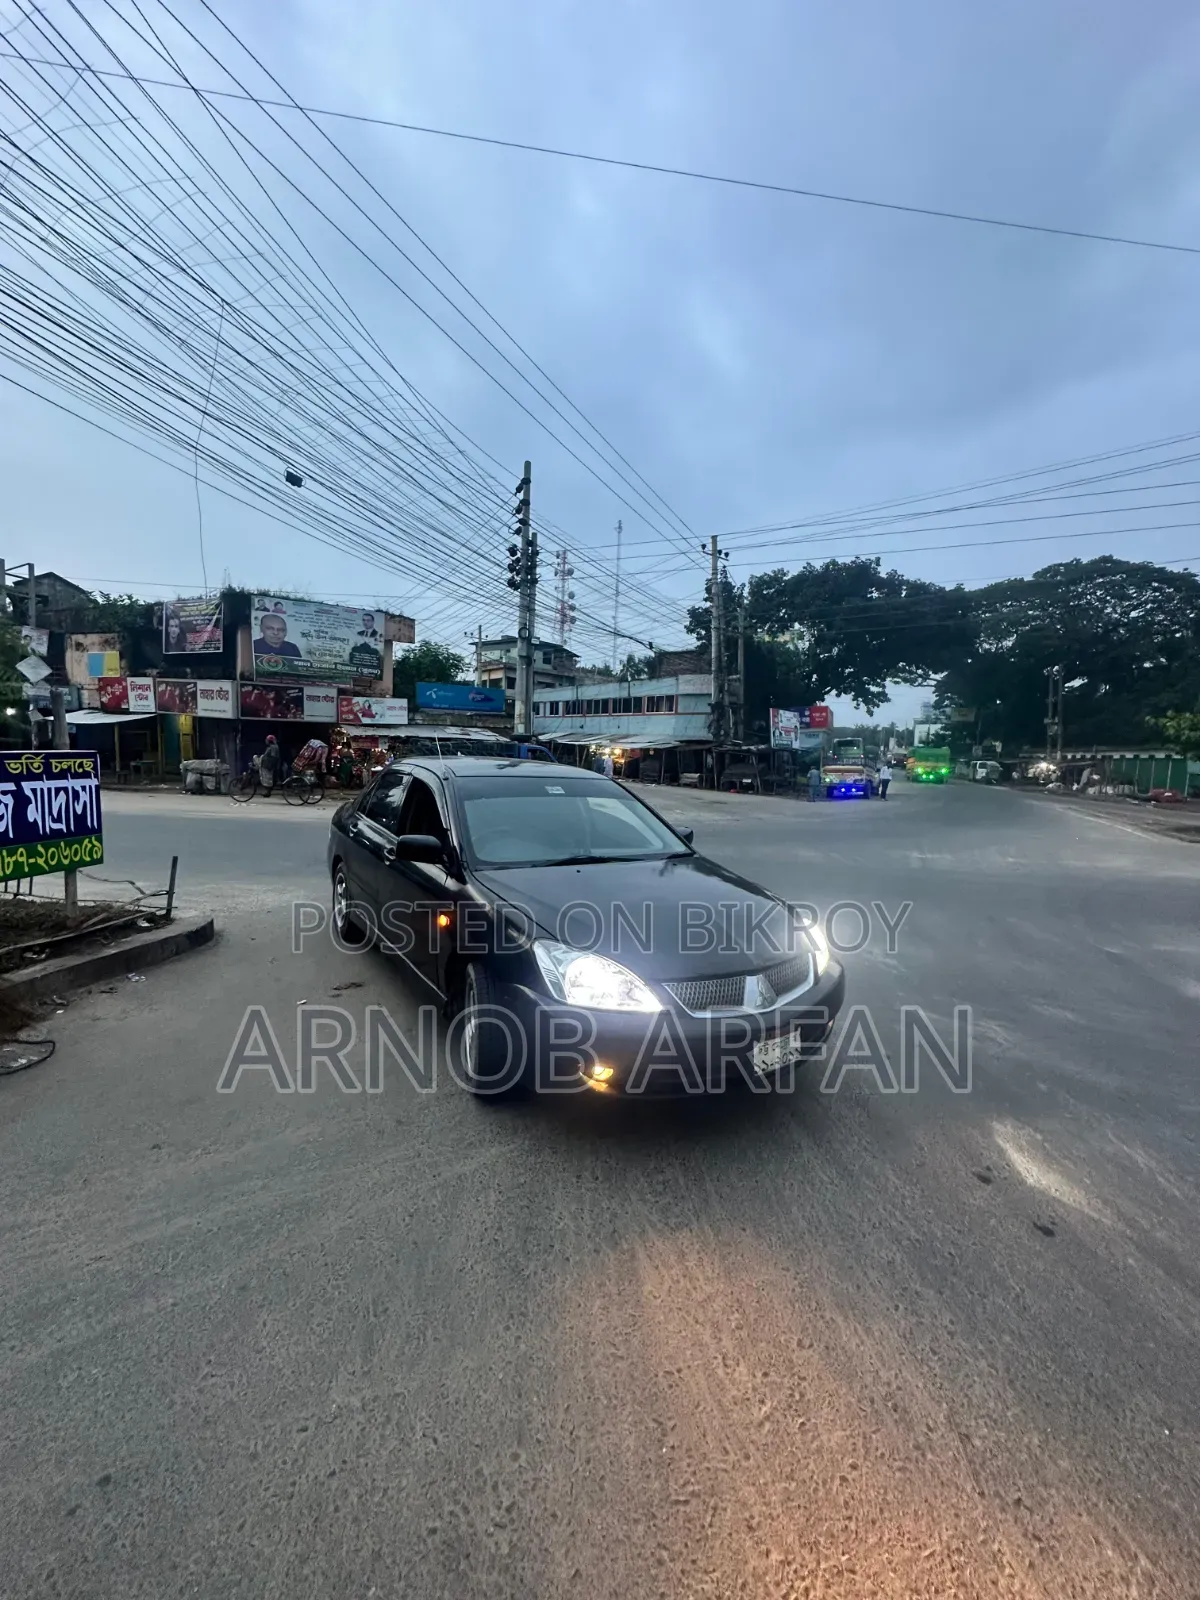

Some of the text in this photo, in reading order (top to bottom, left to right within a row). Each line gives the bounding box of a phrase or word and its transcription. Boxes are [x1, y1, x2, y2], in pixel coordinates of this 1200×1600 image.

[4, 753, 96, 775] ভর্তি চলছে
[21, 773, 100, 835] মাদ্রাসা
[0, 836, 102, 877] ৮৭-২০৬০৫৯
